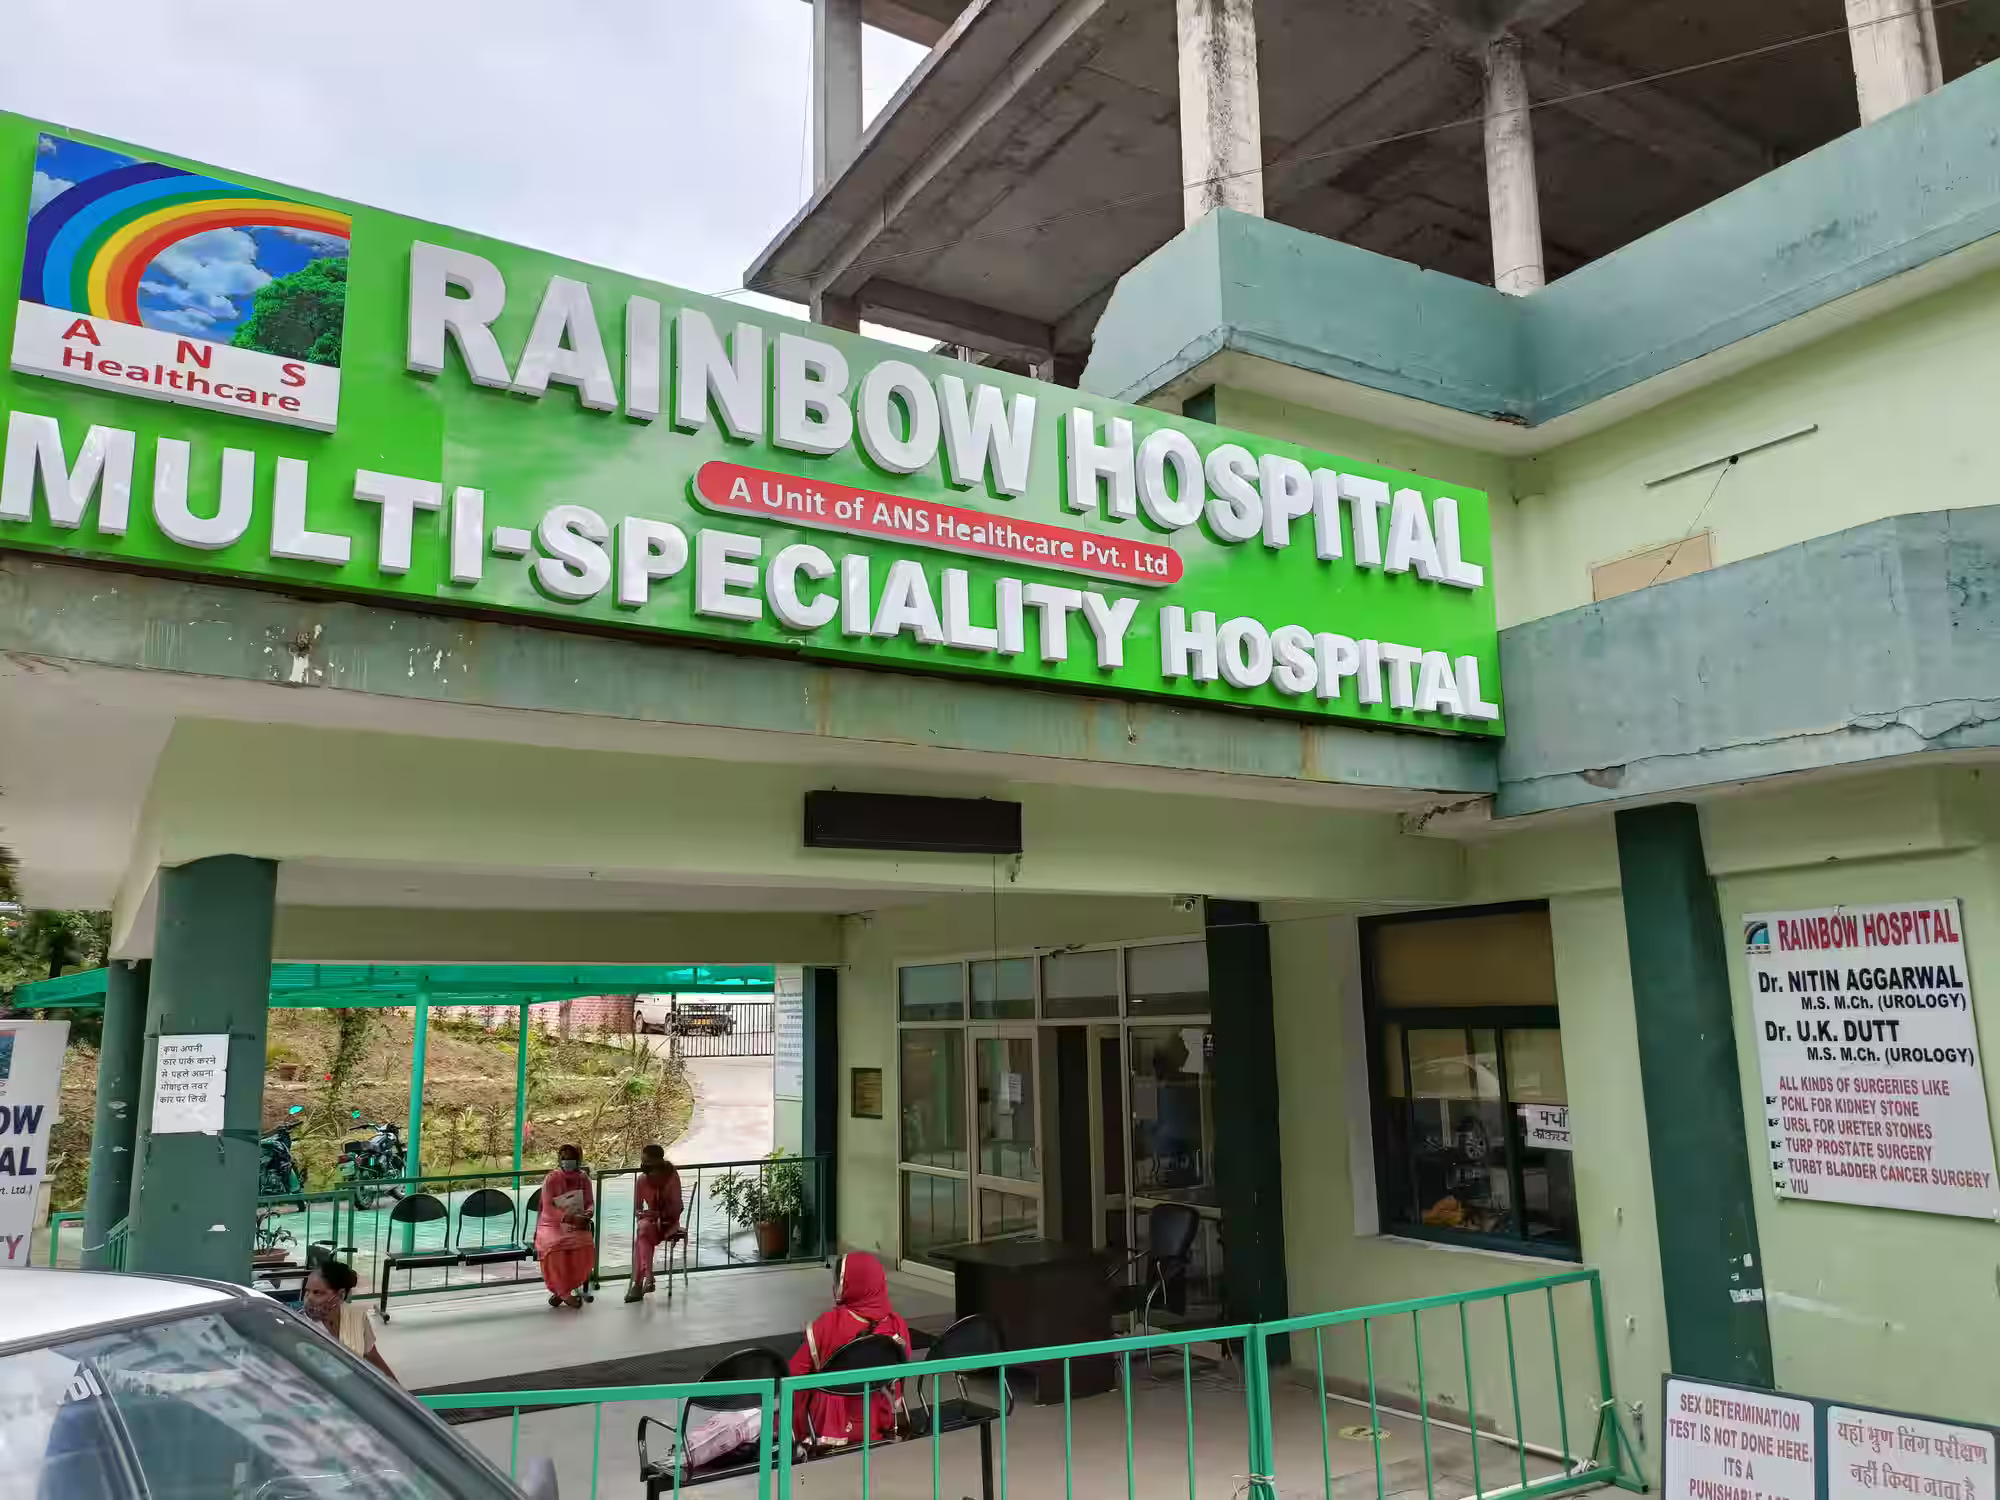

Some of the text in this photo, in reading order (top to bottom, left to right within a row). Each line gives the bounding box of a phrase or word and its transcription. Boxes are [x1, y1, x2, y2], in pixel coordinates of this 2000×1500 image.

[62, 347, 301, 412] Healthcare
[407, 241, 1485, 590] RAINBOW HOSPITAL
[729, 477, 1168, 576] A Unit of ANS Healthcare Pvt. Ltd
[0, 411, 1499, 721] MULTI-SPECIALITY HOSPITAL
[1777, 908, 1959, 951] RAINBOW HOSPITAL
[1758, 965, 1964, 993] Dr. NITIN AGGARWAL
[1801, 993, 1966, 1012] M.S. M.Ch. (UROLOGY)
[1765, 1020, 1900, 1042] Dr. U.K. DUTT
[1807, 1047, 1975, 1067] M.S. M.Ch. (UROLOGY)
[1779, 1076, 1950, 1097] ALL KINDS OF SURGERIES LIKE
[1781, 1096, 1919, 1117] PCNL FOR KIDNEY STONE
[1783, 1118, 1933, 1140] URSL FOR URETER STONES
[1785, 1137, 1932, 1162] TURP PROSTATE SURGERY
[1788, 1157, 1990, 1189] TURBT BLADDER CANCER SURGERY
[1790, 1178, 1809, 1195] VIU
[0, 1234, 24, 1260] Y
[1680, 1393, 1800, 1432] SEX DETERMINATION
[1669, 1418, 1813, 1463] TEST IS NOT DONE HERE.
[1724, 1456, 1754, 1480] ITS A
